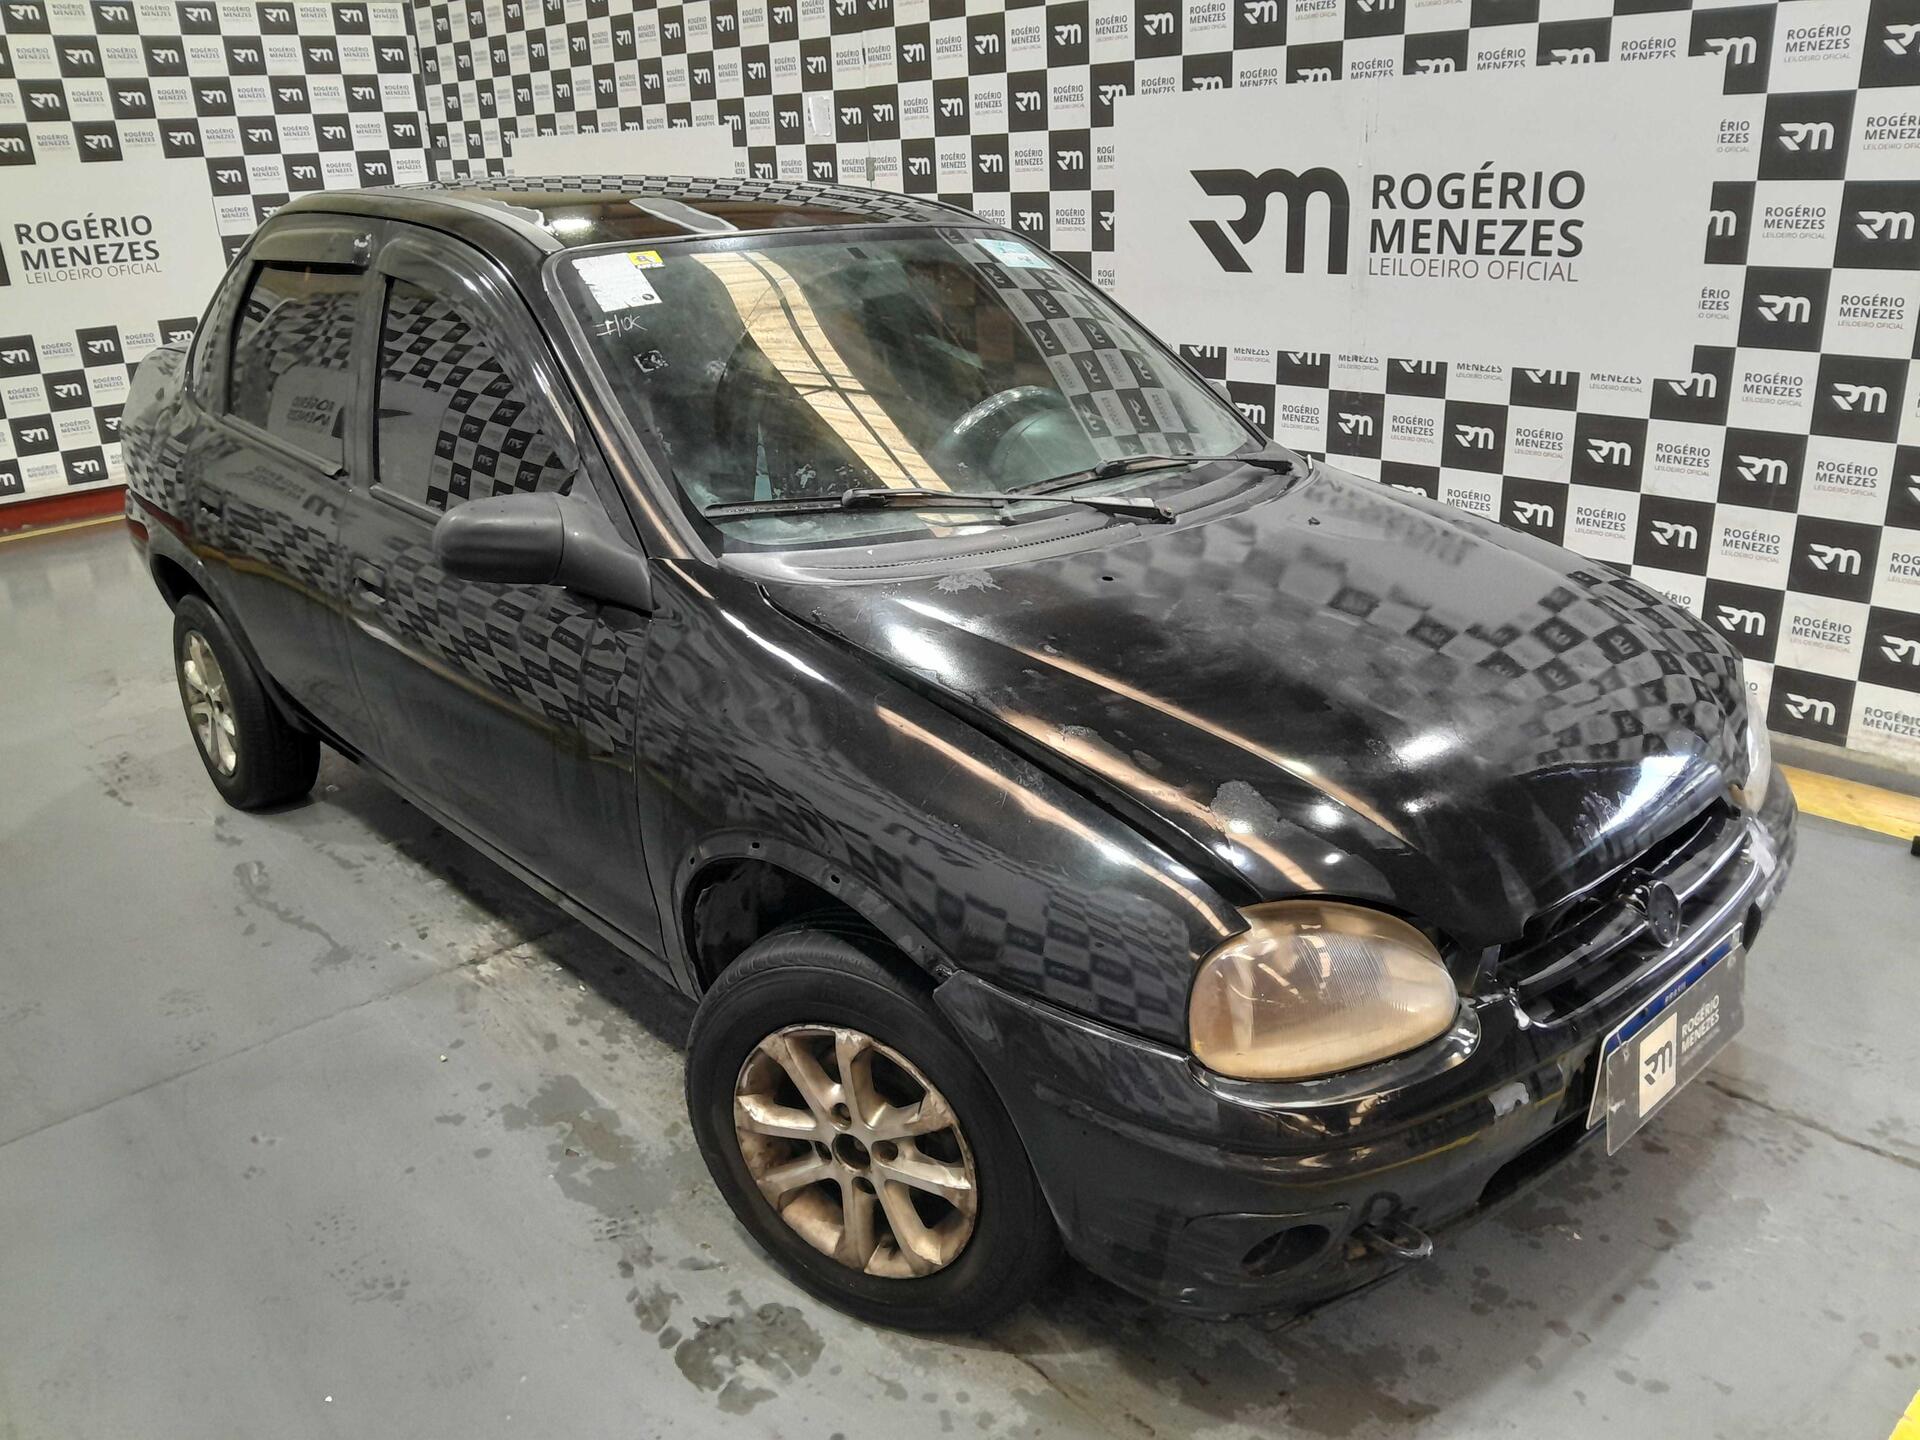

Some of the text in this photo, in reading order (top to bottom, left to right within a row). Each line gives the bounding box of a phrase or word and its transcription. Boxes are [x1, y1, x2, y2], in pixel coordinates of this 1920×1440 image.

[1190, 2, 1225, 15] ROGÉRIO
[1296, 0, 1336, 12] MENEZES
[1096, 15, 1127, 26] ROGÉRIO
[1190, 12, 1226, 24] MENEZES
[1096, 24, 1128, 35] MENEZES
[1787, 24, 1851, 40] ROGÉRIO
[1622, 37, 1676, 51] ROGÉRIO
[1786, 38, 1850, 52] MENEZES
[1478, 48, 1526, 61] ROGÉRIO
[1351, 58, 1393, 70] ROGÉRIO
[1240, 68, 1277, 79] ROGÉRIO
[1142, 76, 1175, 87] ROGÉRIO
[1372, 161, 1585, 210] ROGÉRIO
[1766, 204, 1826, 217] ROGÉRIO
[14, 213, 152, 244] ROGÉRIO
[1764, 219, 1825, 230] MENEZES
[1370, 218, 1584, 258] MENEZES
[20, 240, 160, 271] MENEZES
[26, 262, 162, 284] LEILOEIRO OFICIAL
[1369, 258, 1579, 282] LEILOEIRO OFICIAL
[1841, 294, 1904, 308] ROGÉRIO
[1840, 307, 1904, 320] MENEZES
[1745, 372, 1803, 386] ROGÉRIO
[1743, 384, 1802, 398] MENEZES
[1282, 404, 1319, 415] ROGÉRIO
[1282, 413, 1319, 424] MENEZES
[1392, 415, 1434, 427] ROGÉRIO
[1392, 424, 1434, 436] MENEZES
[1516, 428, 1563, 441] ROGÉRIO
[1515, 438, 1563, 451] MENEZES
[1656, 443, 1710, 457] ROGÉRIO
[1656, 454, 1710, 468] MENEZES
[1817, 461, 1878, 476] ROGÉRIO
[1816, 472, 1877, 488] MENEZES
[1448, 489, 1491, 502] ROGÉRIO
[1447, 498, 1490, 511] MENEZES
[1577, 507, 1626, 521] ROGÉRIO
[1576, 516, 1626, 532] MENEZES
[1724, 528, 1780, 544] ROGÉRIO
[1723, 538, 1779, 555] MENEZES
[1793, 616, 1852, 634] ROGÉRIO
[1792, 626, 1850, 644] MENEZES
[1682, 994, 1720, 1038] ROGÉRIO
[1682, 1009, 1720, 1054] MENEZES
